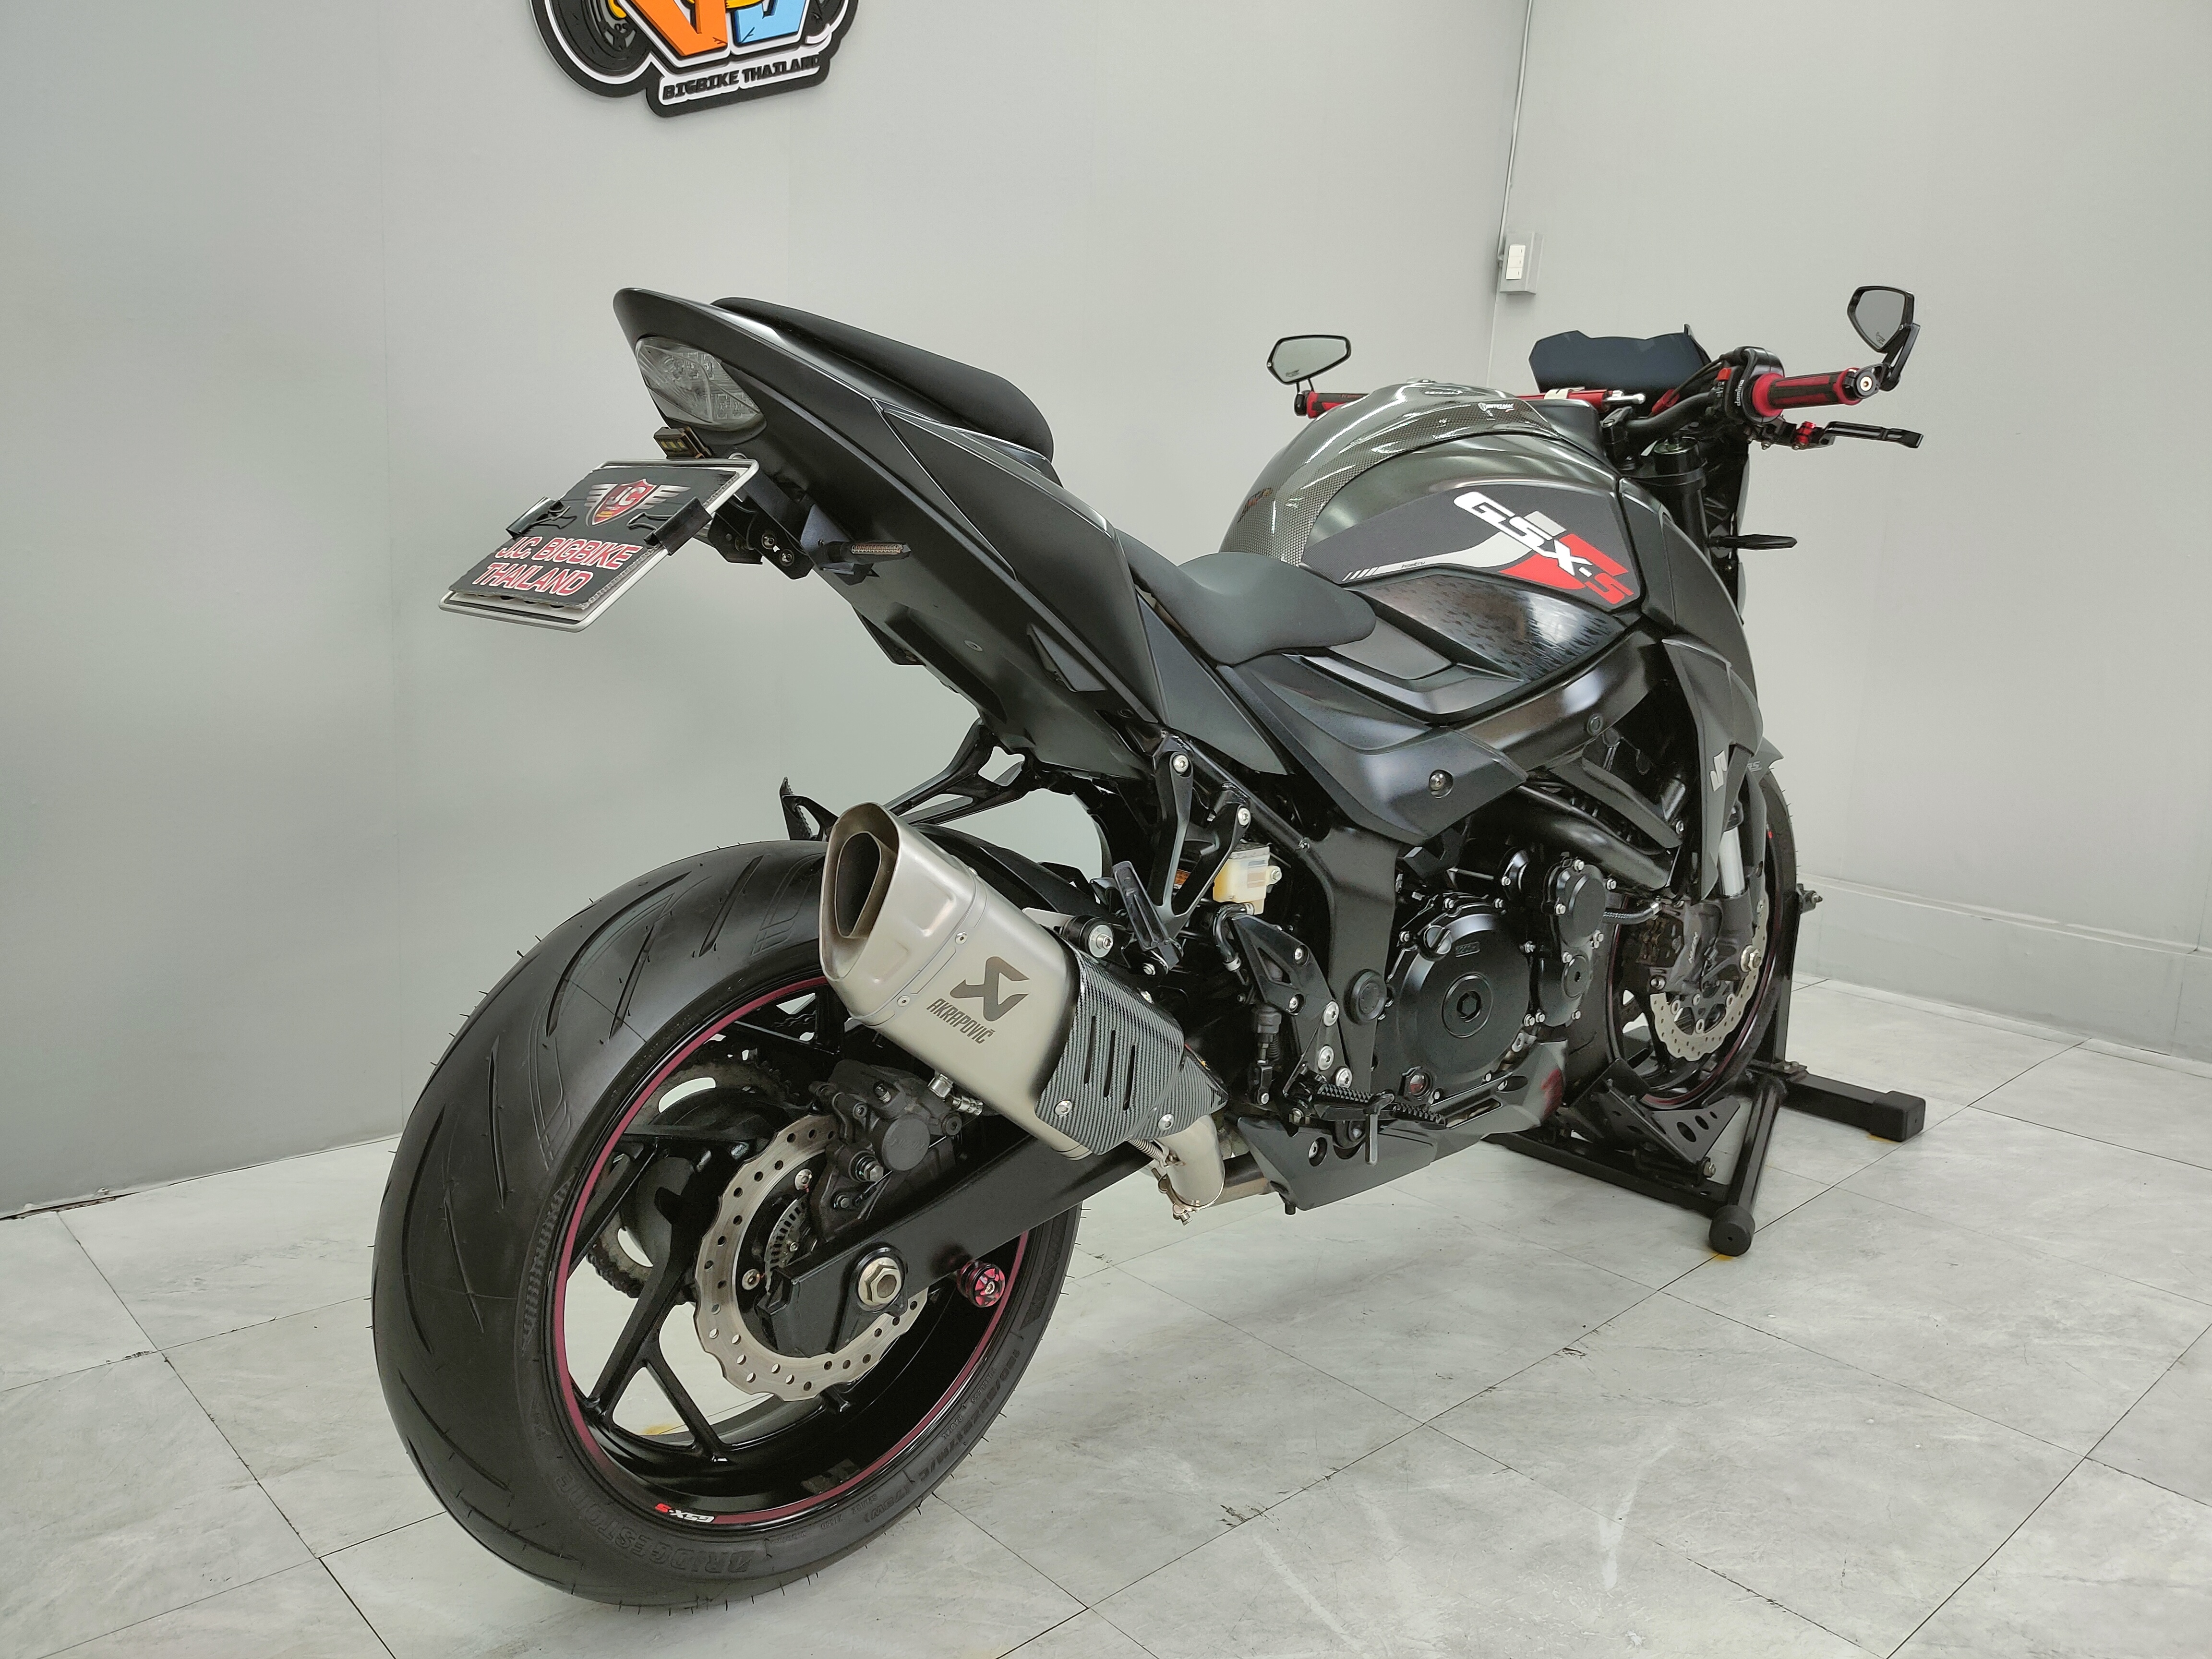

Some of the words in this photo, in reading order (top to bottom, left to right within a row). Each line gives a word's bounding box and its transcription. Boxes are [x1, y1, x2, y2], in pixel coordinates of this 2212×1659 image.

[662, 70, 740, 100] BIGBIKE
[741, 55, 820, 84] THAILAND
[1734, 380, 1744, 406] domino
[605, 486, 647, 506] JC
[531, 537, 644, 570] BIGBIKE
[472, 562, 594, 596] THAILAND
[971, 1367, 996, 1404] TUBELESS
[941, 1414, 964, 1440] RADIAL
[654, 1503, 715, 1523] GSX-S
